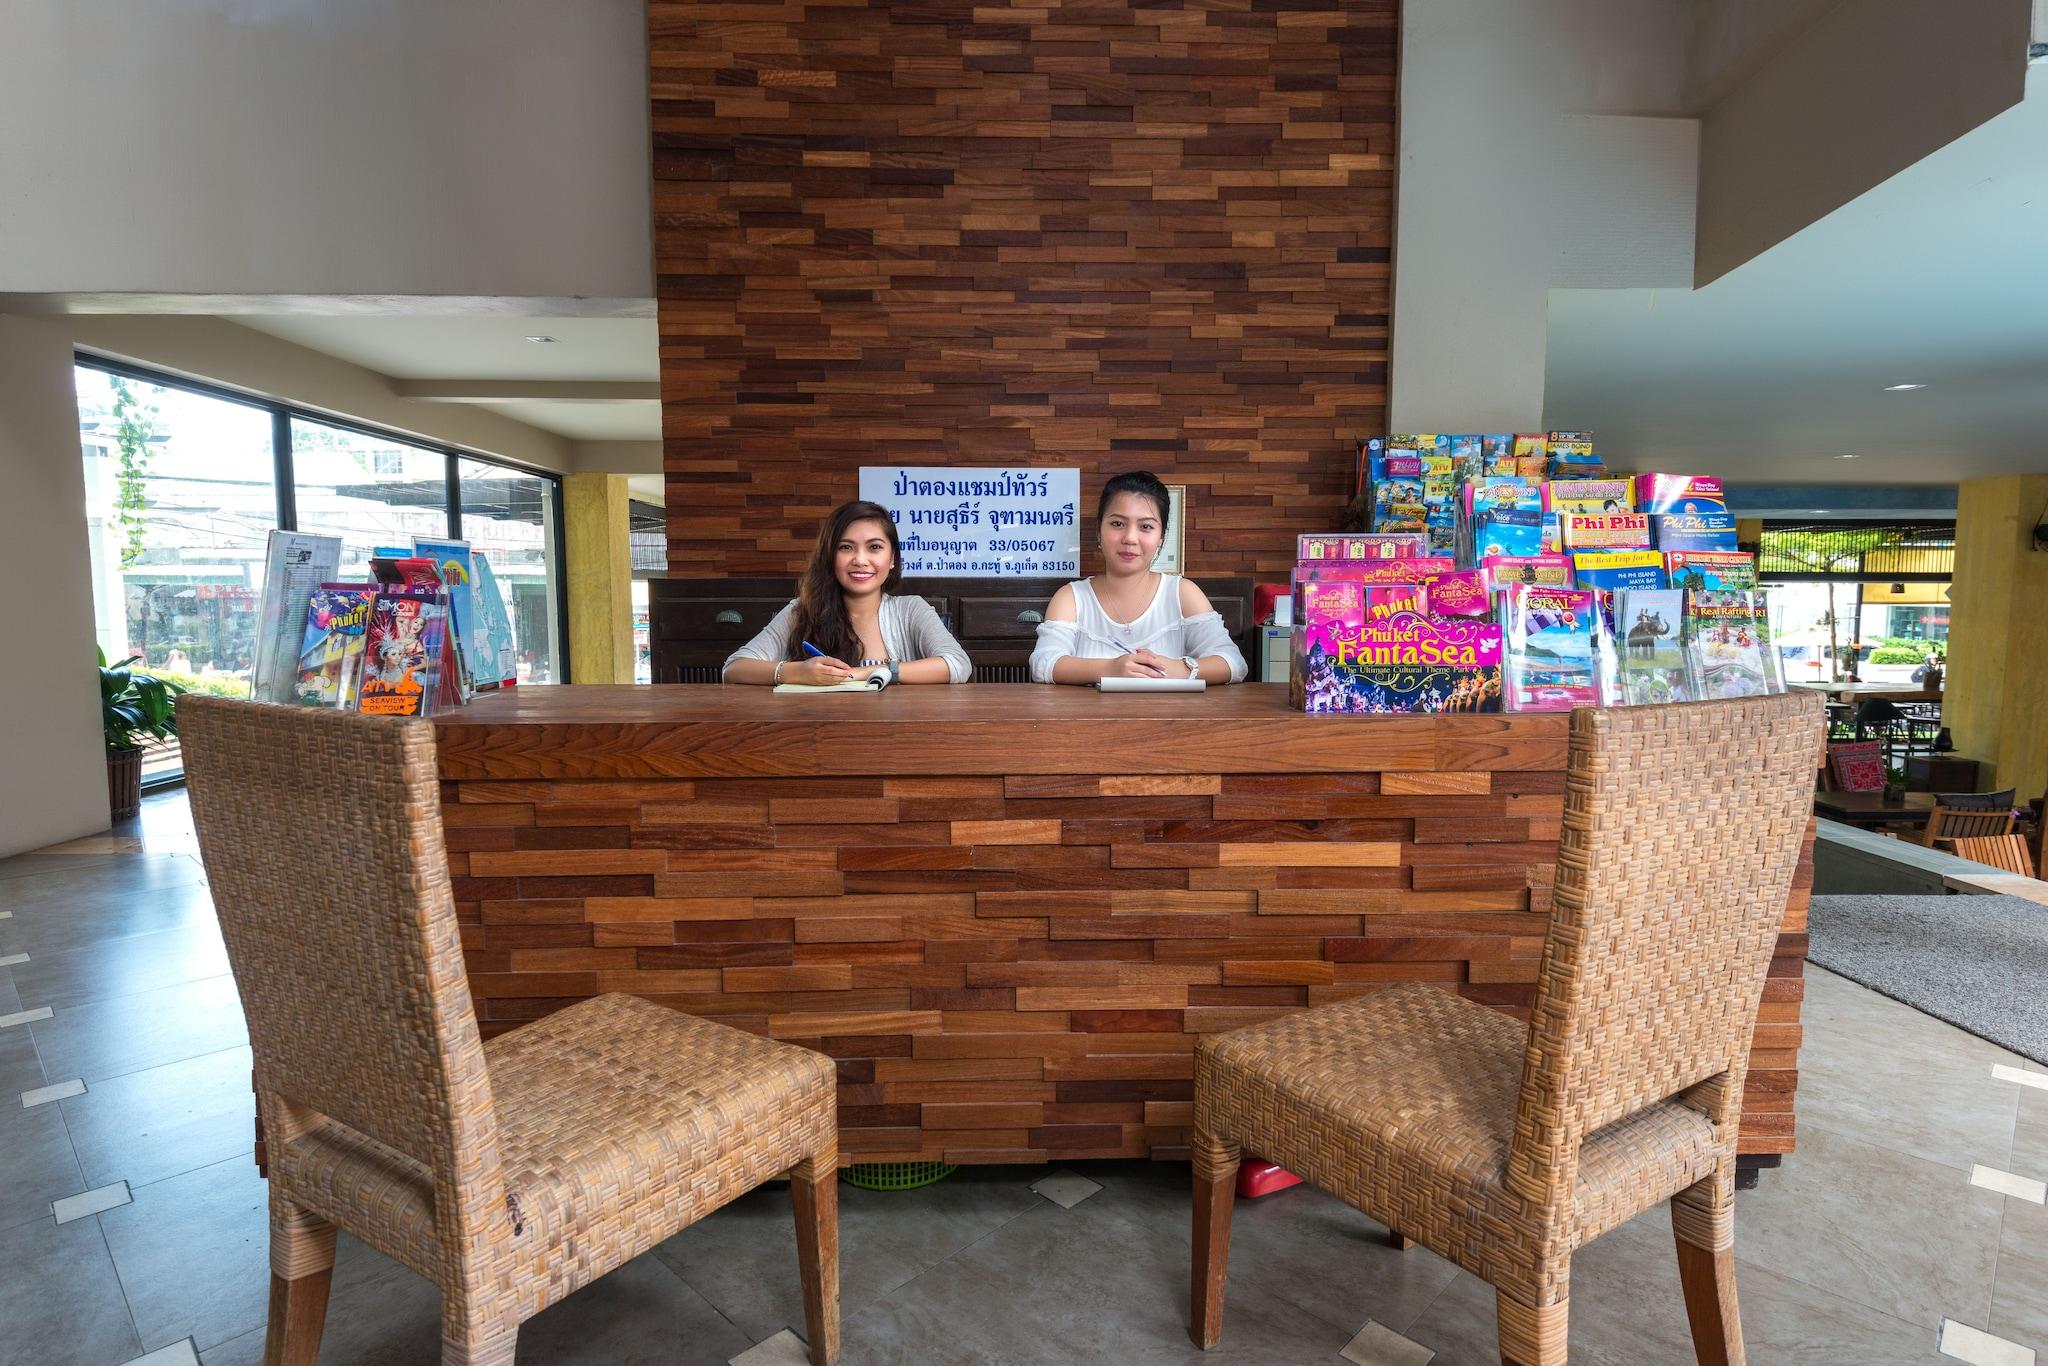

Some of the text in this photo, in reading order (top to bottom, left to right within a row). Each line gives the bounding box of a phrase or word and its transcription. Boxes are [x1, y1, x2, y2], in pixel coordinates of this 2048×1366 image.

[1551, 432, 1558, 441] 8
[1501, 459, 1515, 467] ATV
[894, 471, 1048, 497] ป่าตองแชมป์ทัวร์
[910, 502, 980, 532] นายสุธีร์
[989, 503, 1075, 532] จุฑามนตรี
[1572, 516, 1646, 529] Phi Phi
[1663, 516, 1707, 529] Phi Phi
[899, 531, 1055, 556] ขที่ใบอนุญาต 33/05067
[1581, 556, 1593, 564] The
[1597, 555, 1611, 564] Best
[1615, 554, 1629, 565] Trip
[1631, 553, 1643, 565] for
[927, 557, 967, 571] ต.ป่าตอง
[971, 558, 1001, 574] อ.กะทู้
[1005, 557, 1038, 575] จ.ภูเก็ต
[1042, 560, 1075, 571] 83150
[1432, 586, 1483, 599] FantaSea
[377, 601, 416, 612] SIMON
[1312, 598, 1359, 609] FantaSea
[1373, 596, 1419, 620] Phuket
[1700, 607, 1720, 616] Real
[1721, 606, 1752, 618] Rafting
[331, 612, 364, 630] Phuket
[1360, 627, 1420, 643] Phuket
[1337, 638, 1477, 667] FantaSea
[1343, 666, 1471, 674] The Ultimate Cultural Theme Park
